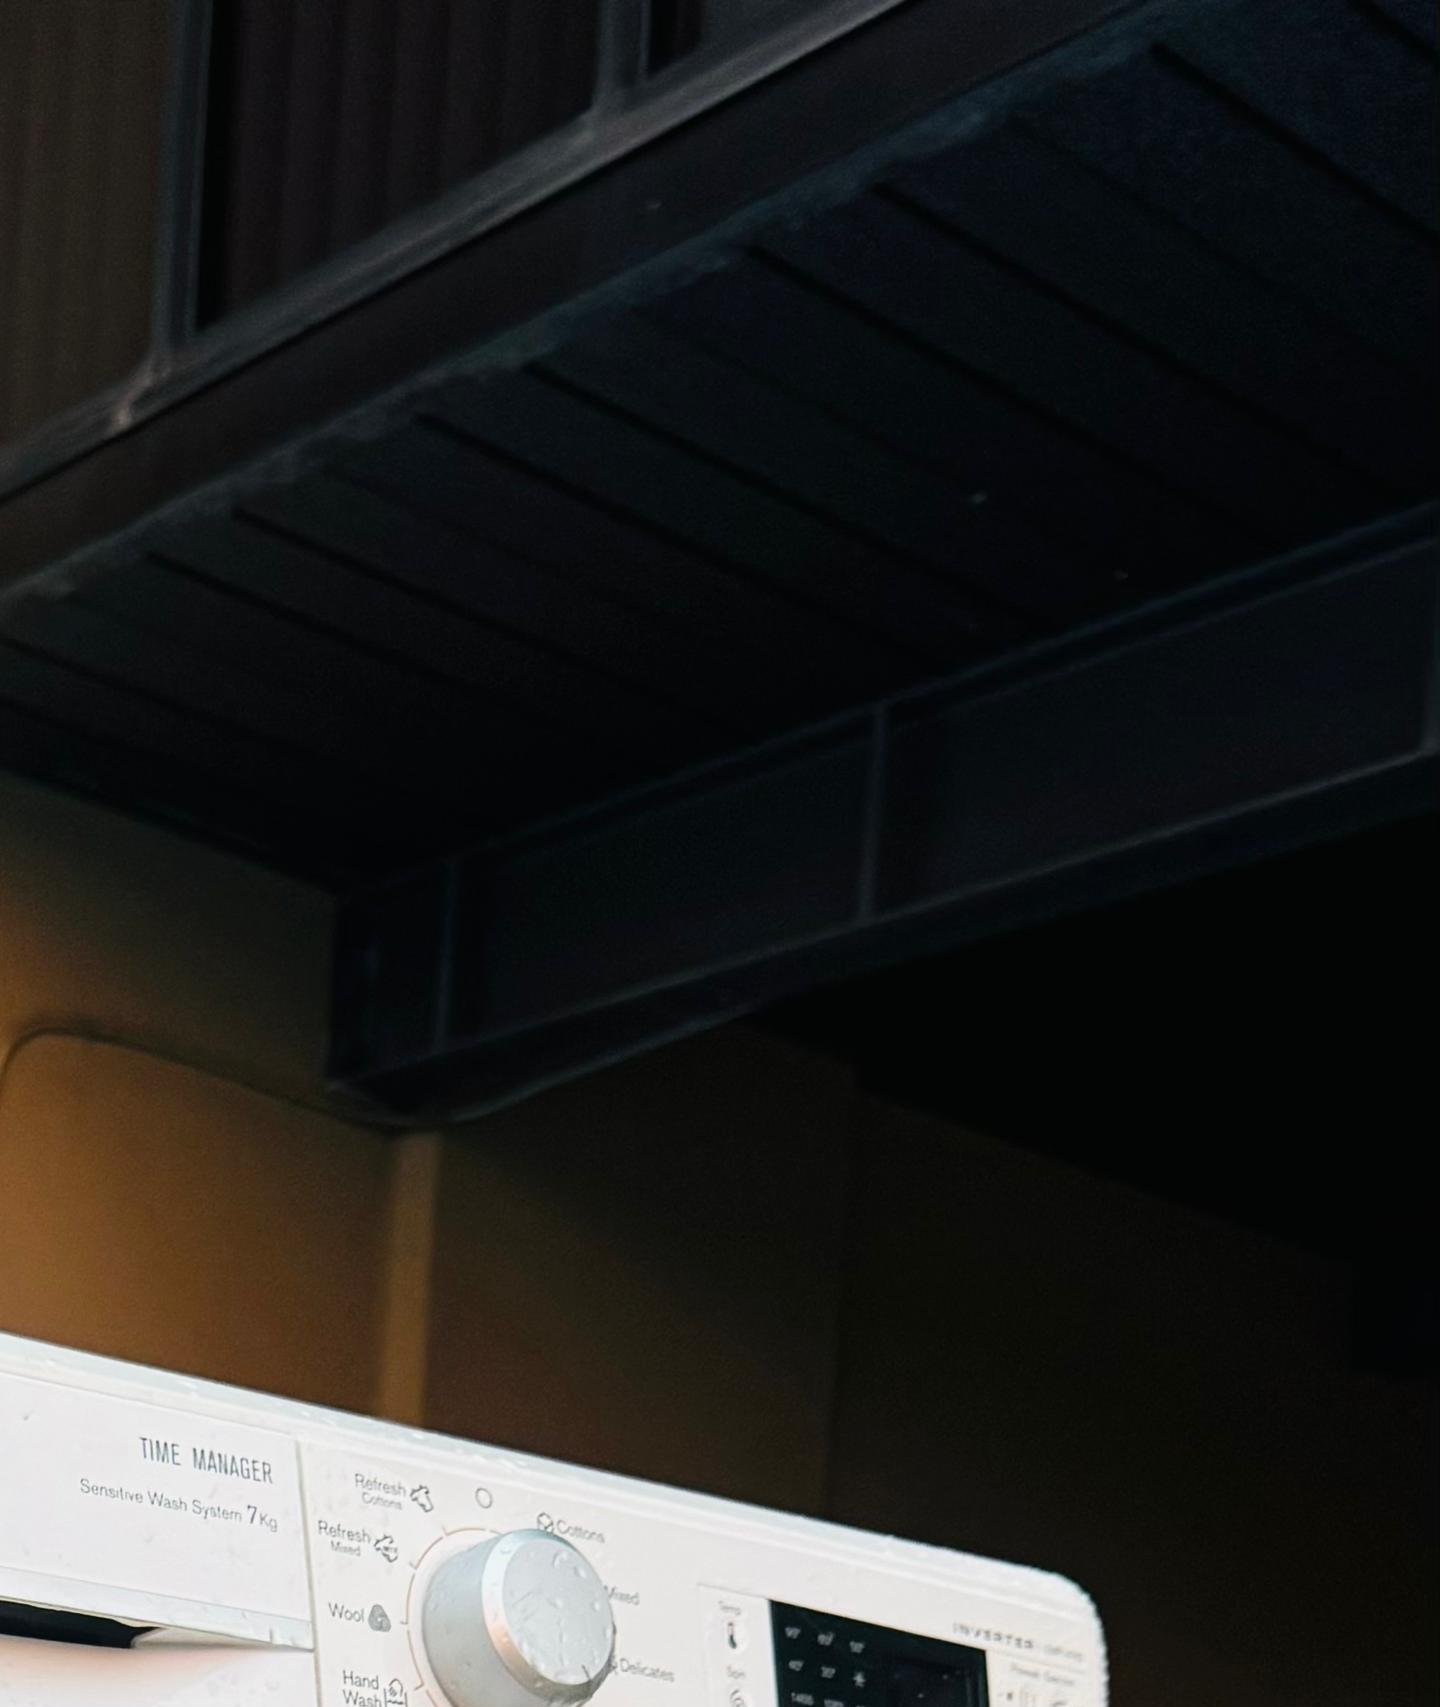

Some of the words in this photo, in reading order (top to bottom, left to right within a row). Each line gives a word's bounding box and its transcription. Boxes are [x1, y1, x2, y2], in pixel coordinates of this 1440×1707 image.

[139, 1436, 182, 1466] TIME
[192, 1447, 274, 1484] MANAGER
[355, 1472, 407, 1498] Refresh
[80, 1477, 144, 1505] Sensitive
[148, 1490, 188, 1512] Wash
[192, 1498, 243, 1523] System
[317, 1519, 371, 1544] Refresh
[556, 1519, 607, 1545] Cottons
[327, 1601, 365, 1623] Wool
[952, 1621, 1035, 1650] INVERTER
[342, 1669, 379, 1690] Hand
[619, 1657, 675, 1684] Delicates
